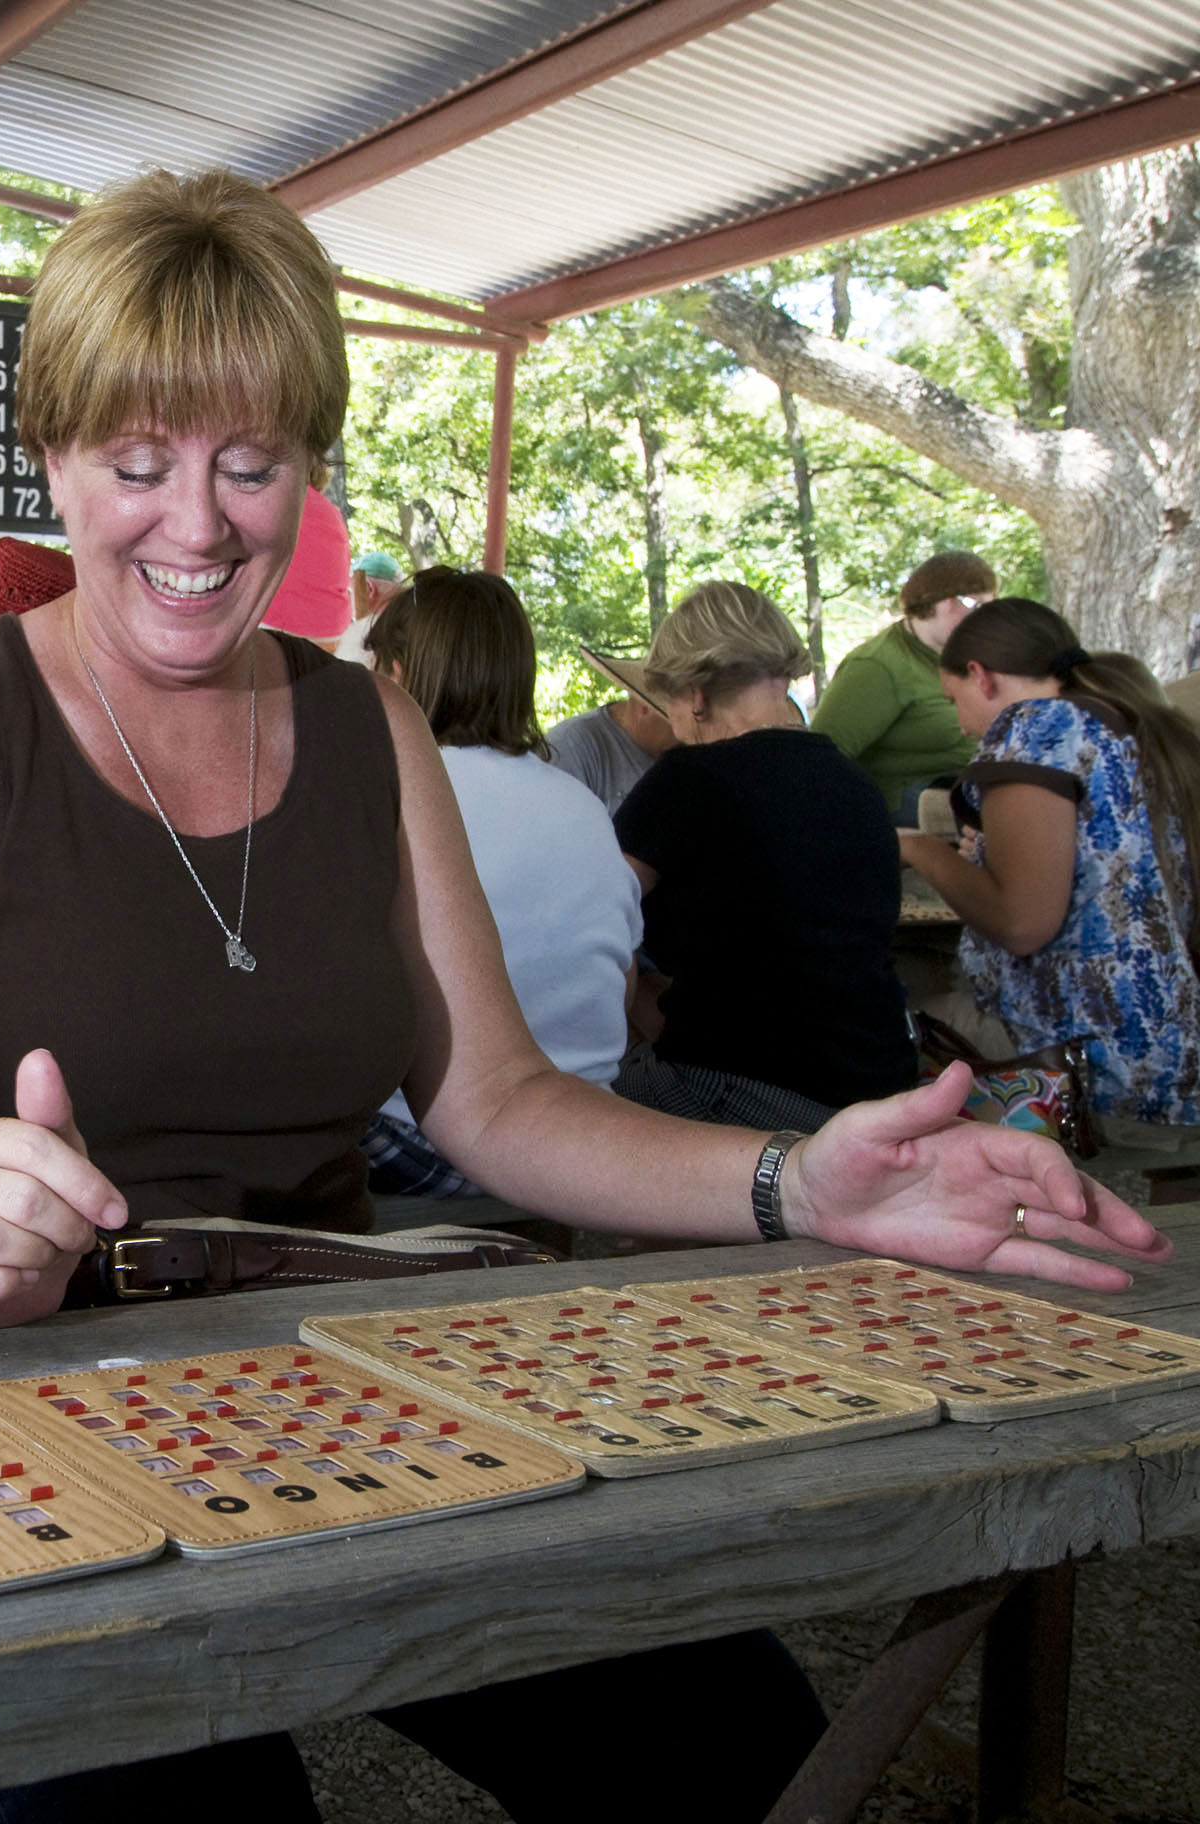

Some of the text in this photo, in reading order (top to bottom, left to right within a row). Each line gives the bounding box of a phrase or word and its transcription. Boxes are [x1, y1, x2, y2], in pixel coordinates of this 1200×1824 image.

[12, 486, 41, 519] 72
[204, 1452, 507, 1514] B I N G O
[26, 1523, 73, 1542] B
